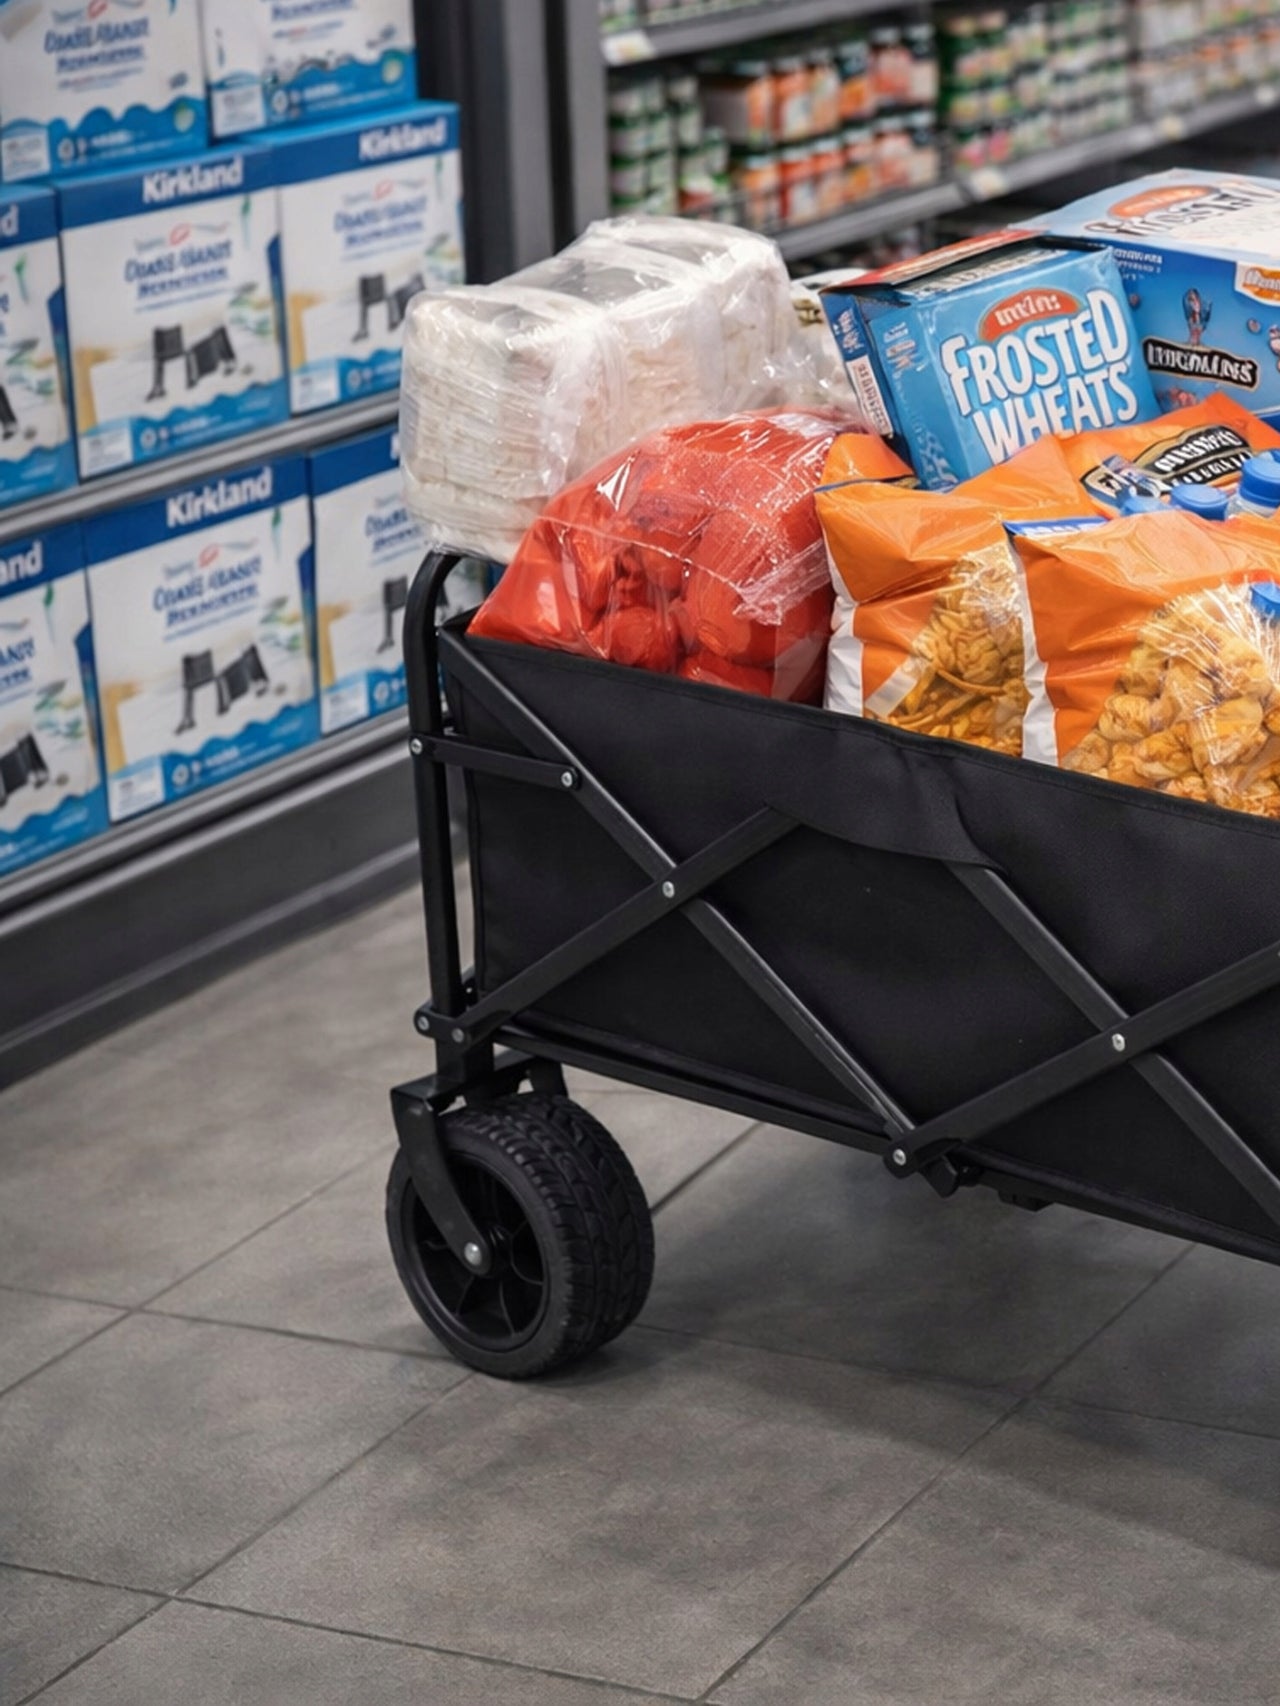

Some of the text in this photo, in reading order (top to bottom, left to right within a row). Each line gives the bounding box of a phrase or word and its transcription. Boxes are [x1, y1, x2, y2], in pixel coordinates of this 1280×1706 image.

[359, 117, 447, 161] Kirkland
[143, 153, 244, 204] Kirkland
[940, 289, 1129, 417] FROSTED
[972, 361, 1138, 466] WHEATS
[166, 466, 273, 529] Kirkland
